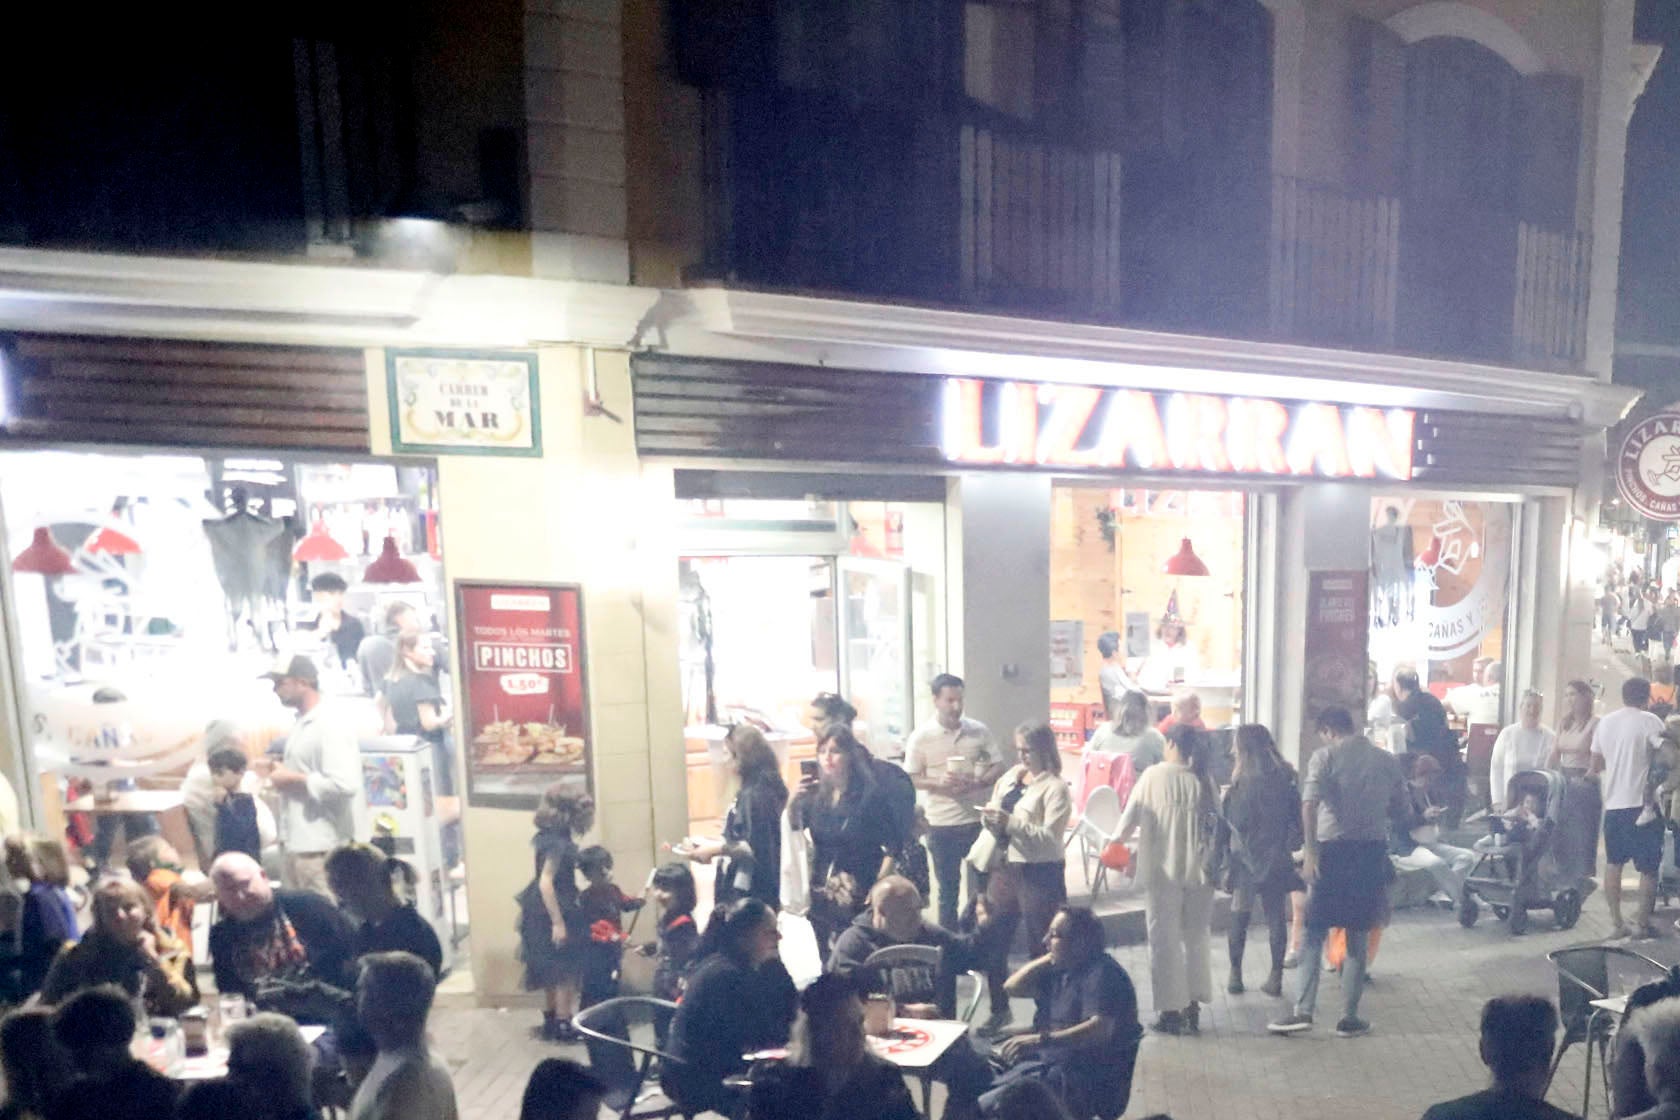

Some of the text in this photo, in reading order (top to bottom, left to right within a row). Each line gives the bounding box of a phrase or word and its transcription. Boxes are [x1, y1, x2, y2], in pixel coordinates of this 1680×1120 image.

[434, 410, 499, 429] MAR
[944, 378, 1416, 481] LIZARRAN
[480, 645, 567, 669] PINCHOS
